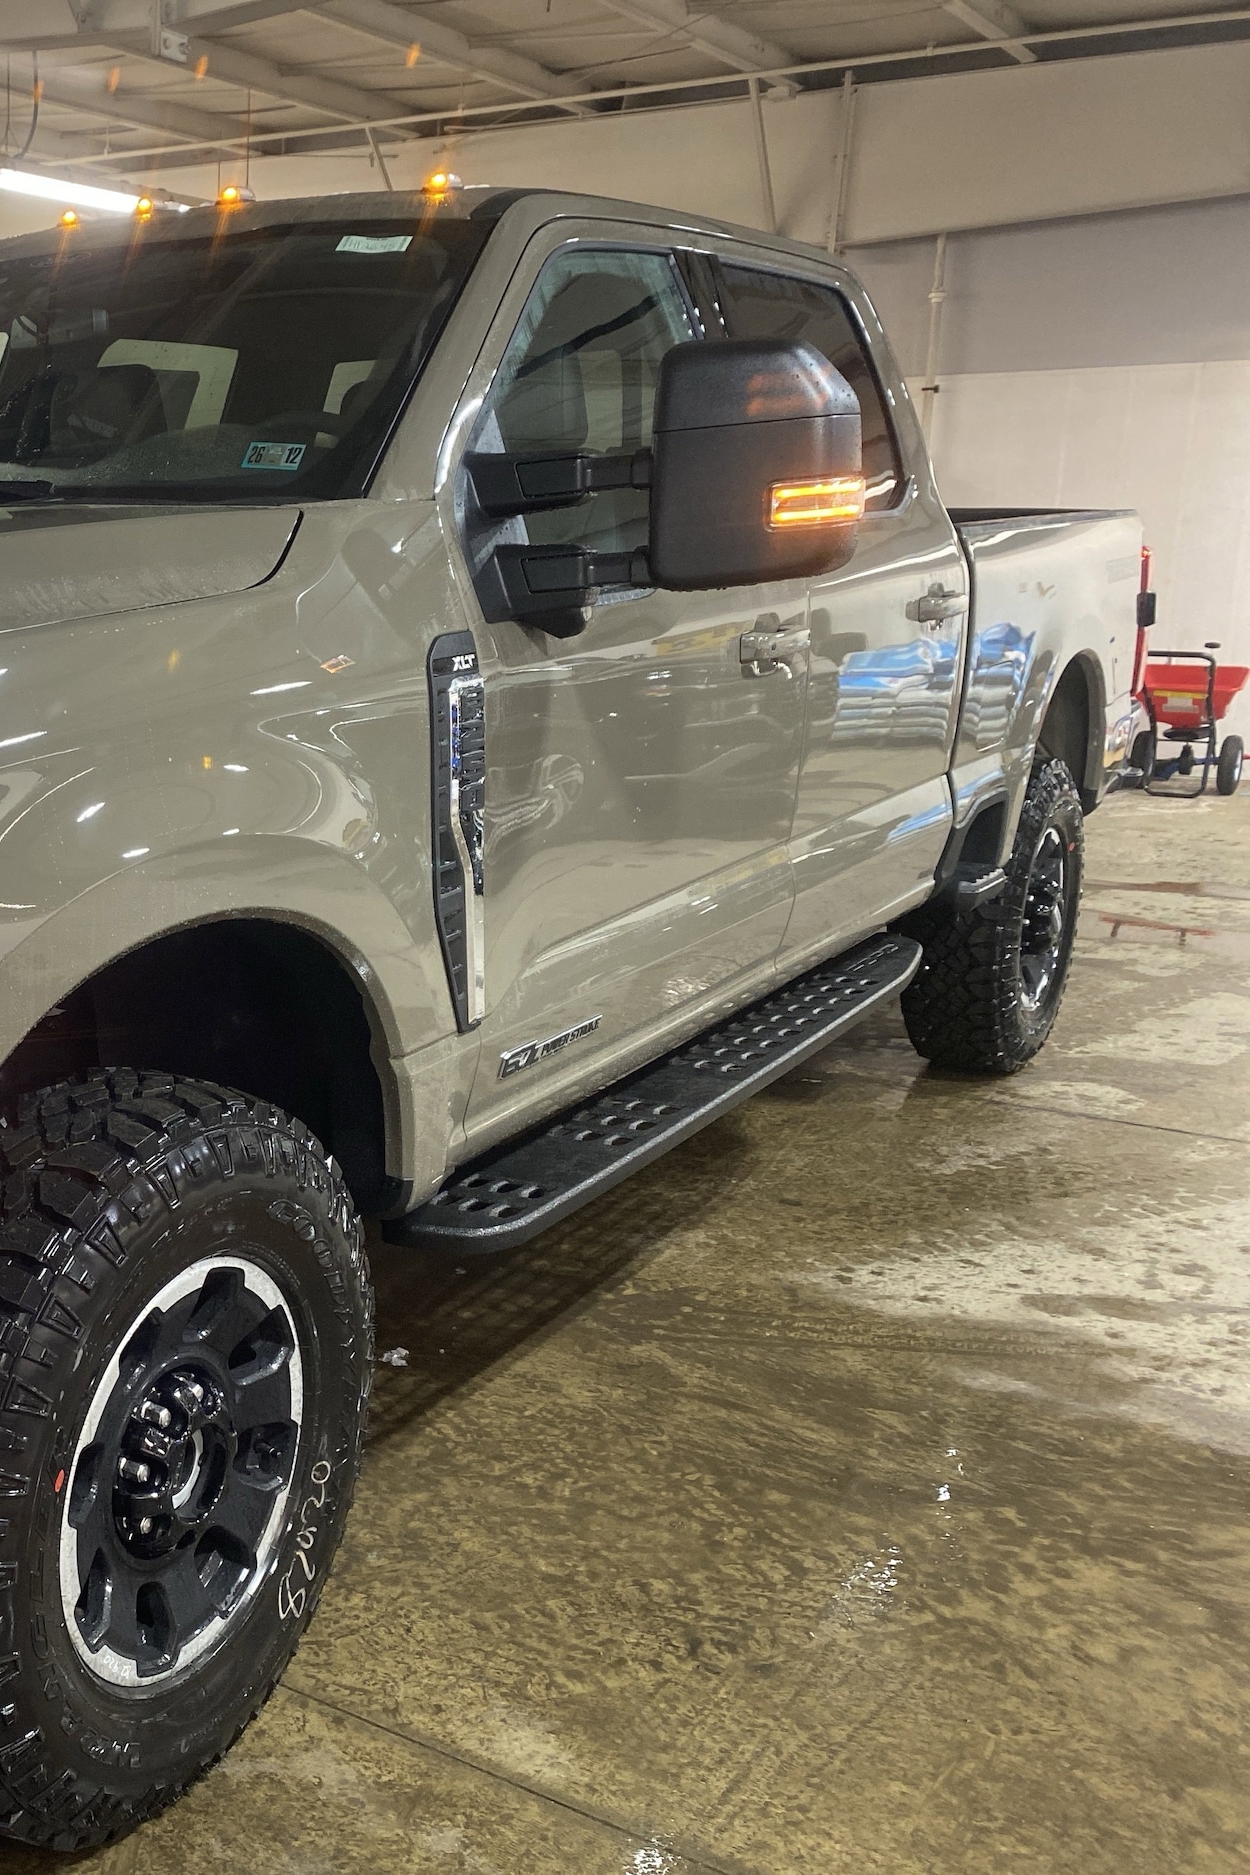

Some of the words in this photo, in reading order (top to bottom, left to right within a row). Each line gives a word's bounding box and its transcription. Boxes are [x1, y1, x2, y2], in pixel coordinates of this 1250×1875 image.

[248, 446, 266, 464] 26
[284, 446, 303, 464] 12
[452, 653, 475, 672] XLT
